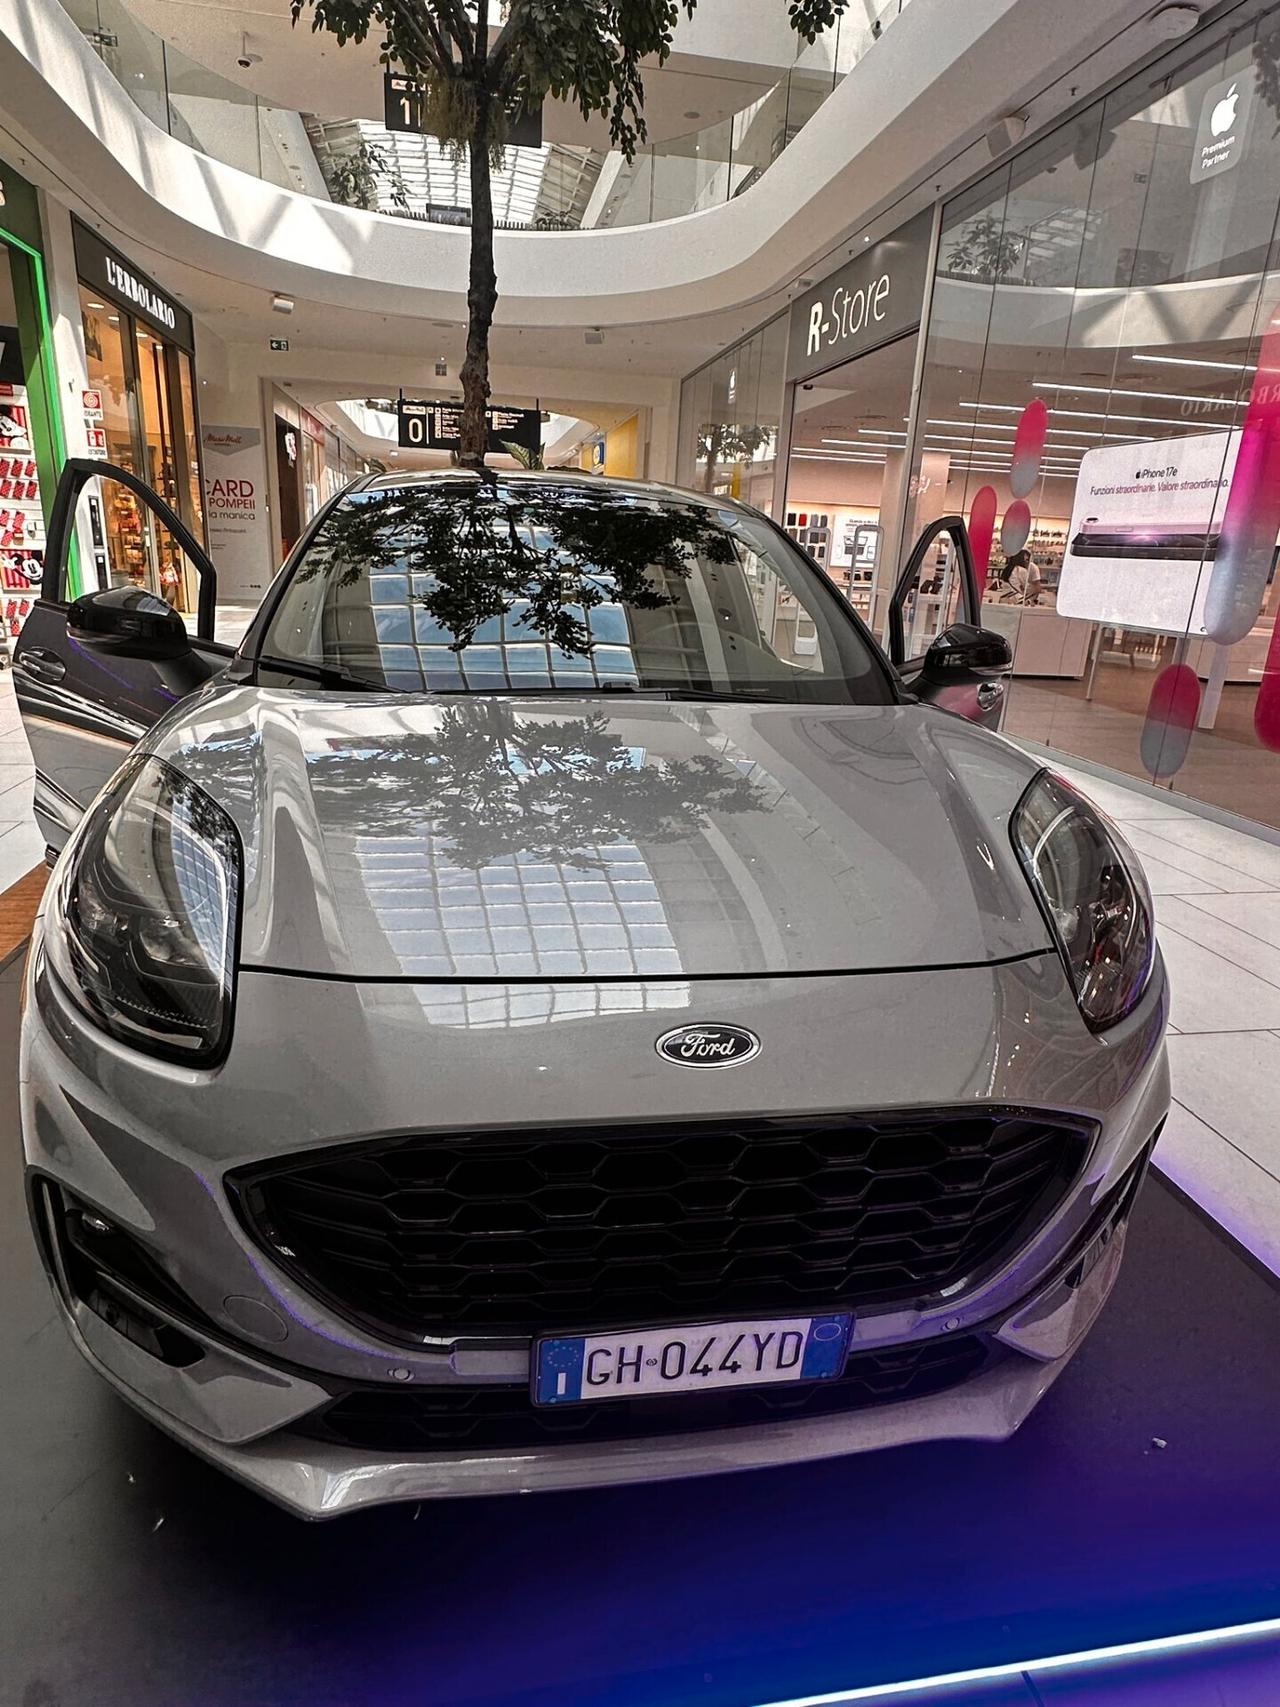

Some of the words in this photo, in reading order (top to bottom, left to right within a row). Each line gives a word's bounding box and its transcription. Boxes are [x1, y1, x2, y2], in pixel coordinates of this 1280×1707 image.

[400, 97, 410, 125] 1
[1201, 135, 1236, 157] Premium
[1201, 150, 1231, 169] Partner
[105, 256, 176, 329] L'ERBOLARIO
[807, 274, 890, 357] R-Store
[408, 418, 423, 443] 0
[1141, 469, 1165, 478] iPhone
[1166, 467, 1178, 477] 17e
[1090, 486, 1115, 495] Funzioni
[1157, 481, 1179, 492] Valore
[208, 497, 256, 510] POMPEII
[220, 511, 256, 520] manica
[681, 1033, 736, 1057] Ford
[586, 1345, 644, 1386] GH
[660, 1331, 804, 1380] 044YD
